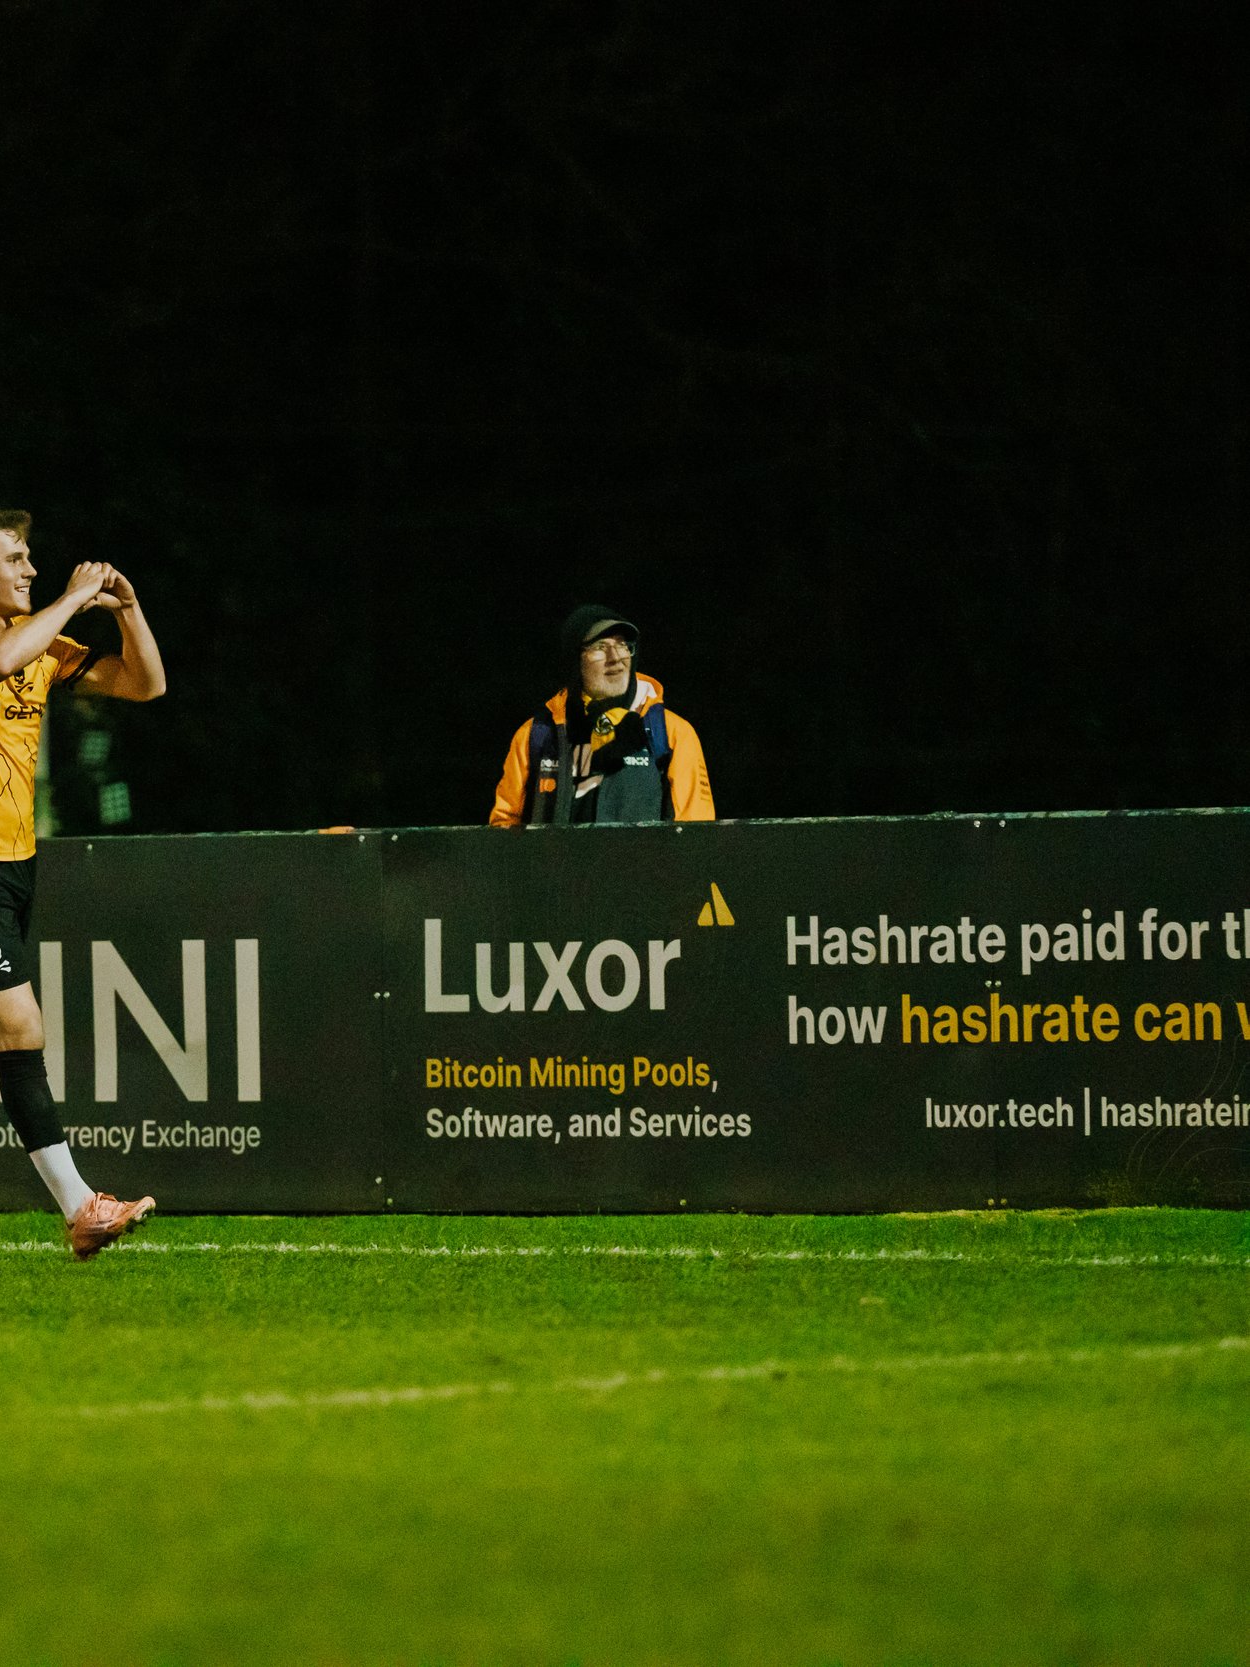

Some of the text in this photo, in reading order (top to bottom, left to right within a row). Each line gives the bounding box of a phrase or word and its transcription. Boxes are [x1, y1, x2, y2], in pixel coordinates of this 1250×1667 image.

[786, 914, 1006, 965] Hashrate
[1021, 909, 1125, 975] paid
[1139, 908, 1209, 960] for
[424, 918, 681, 1013] Luxor
[788, 995, 888, 1045] how
[902, 993, 1120, 1044] hashrate
[1134, 1002, 1222, 1041] can
[426, 1056, 718, 1095] Bitcoin Mining Pools,
[426, 1105, 752, 1144] Software, and Services
[926, 1096, 1073, 1128] luxor.tech
[142, 1120, 261, 1155] Exchange
